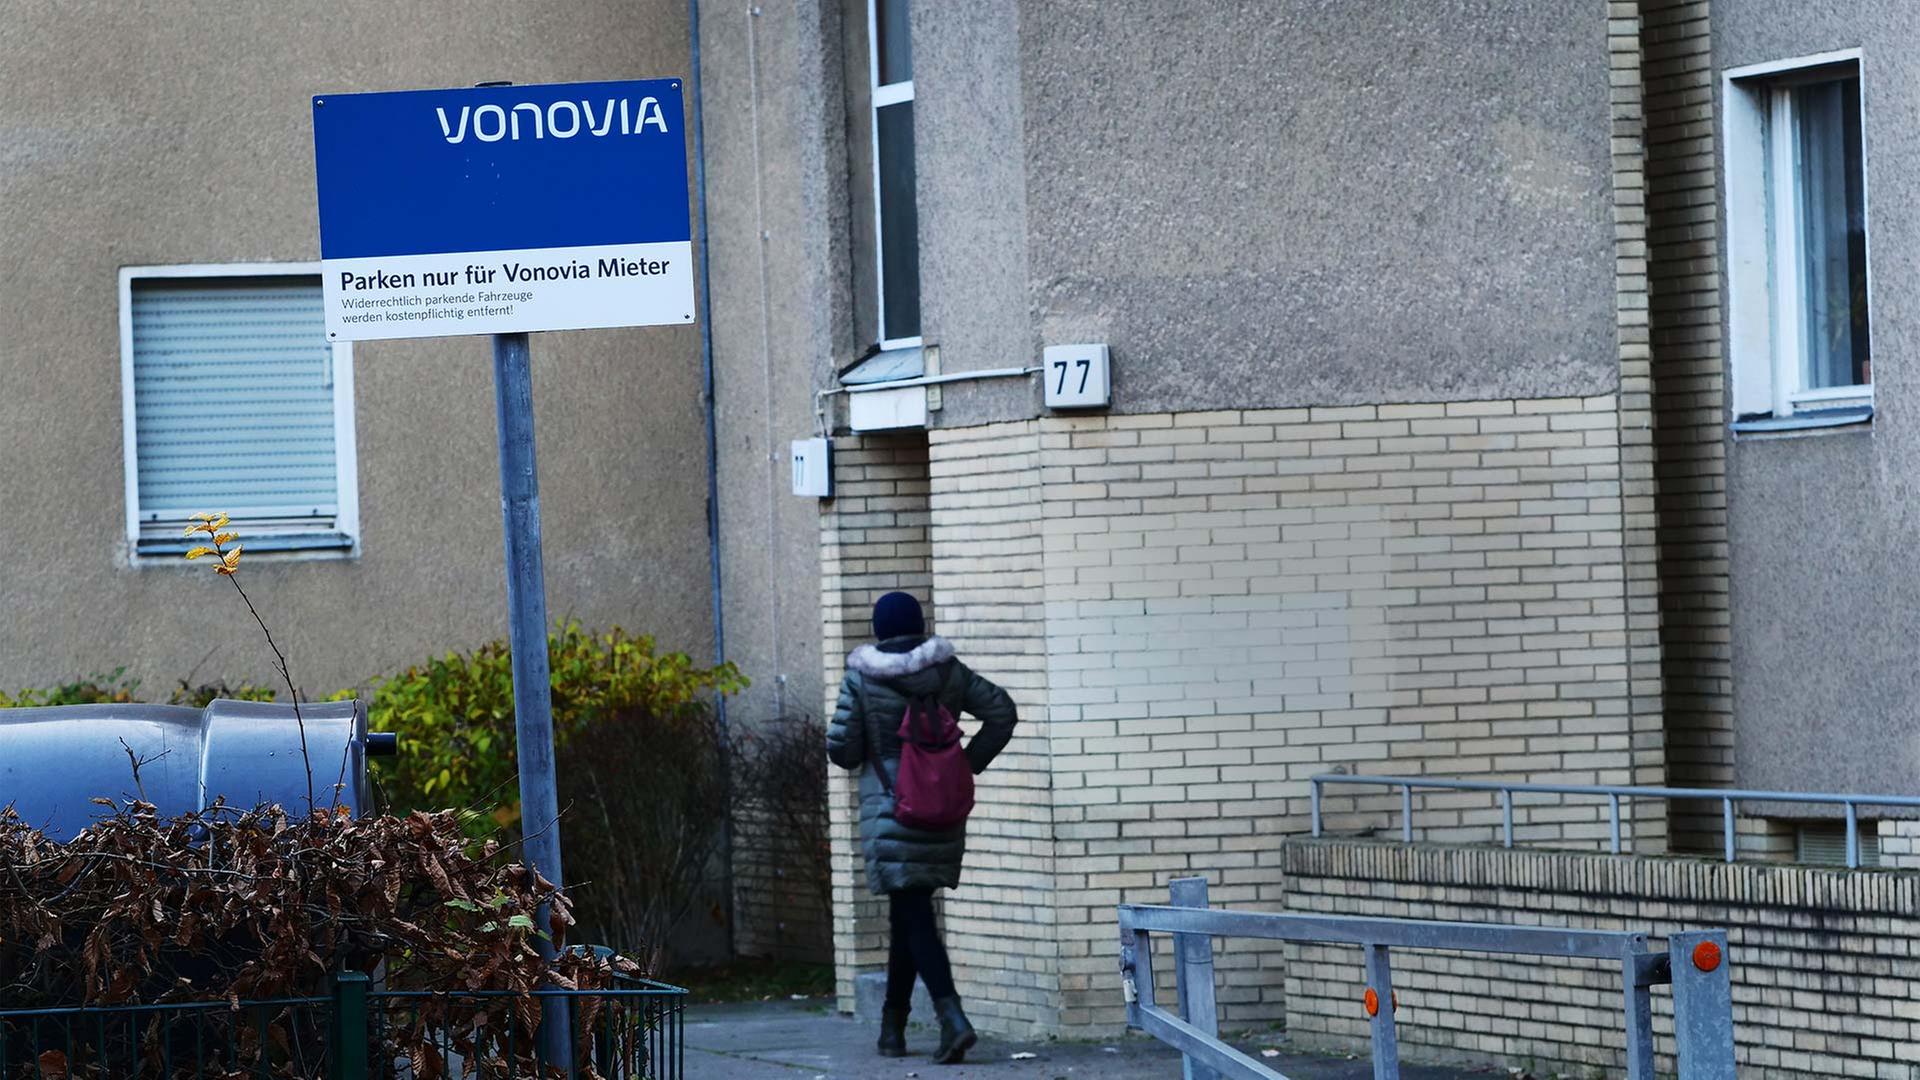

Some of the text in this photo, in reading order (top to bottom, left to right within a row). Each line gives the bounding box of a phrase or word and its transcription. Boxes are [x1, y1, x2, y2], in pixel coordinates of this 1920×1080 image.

[436, 97, 668, 144] VONOVIA
[341, 257, 670, 291] Parken nur für Vonovia Mieter
[341, 290, 534, 310] Widerrechtlich parkende Fahrzeuge
[342, 304, 515, 324] werden kostenpflichtig entfernt!
[1053, 359, 1091, 395] 77
